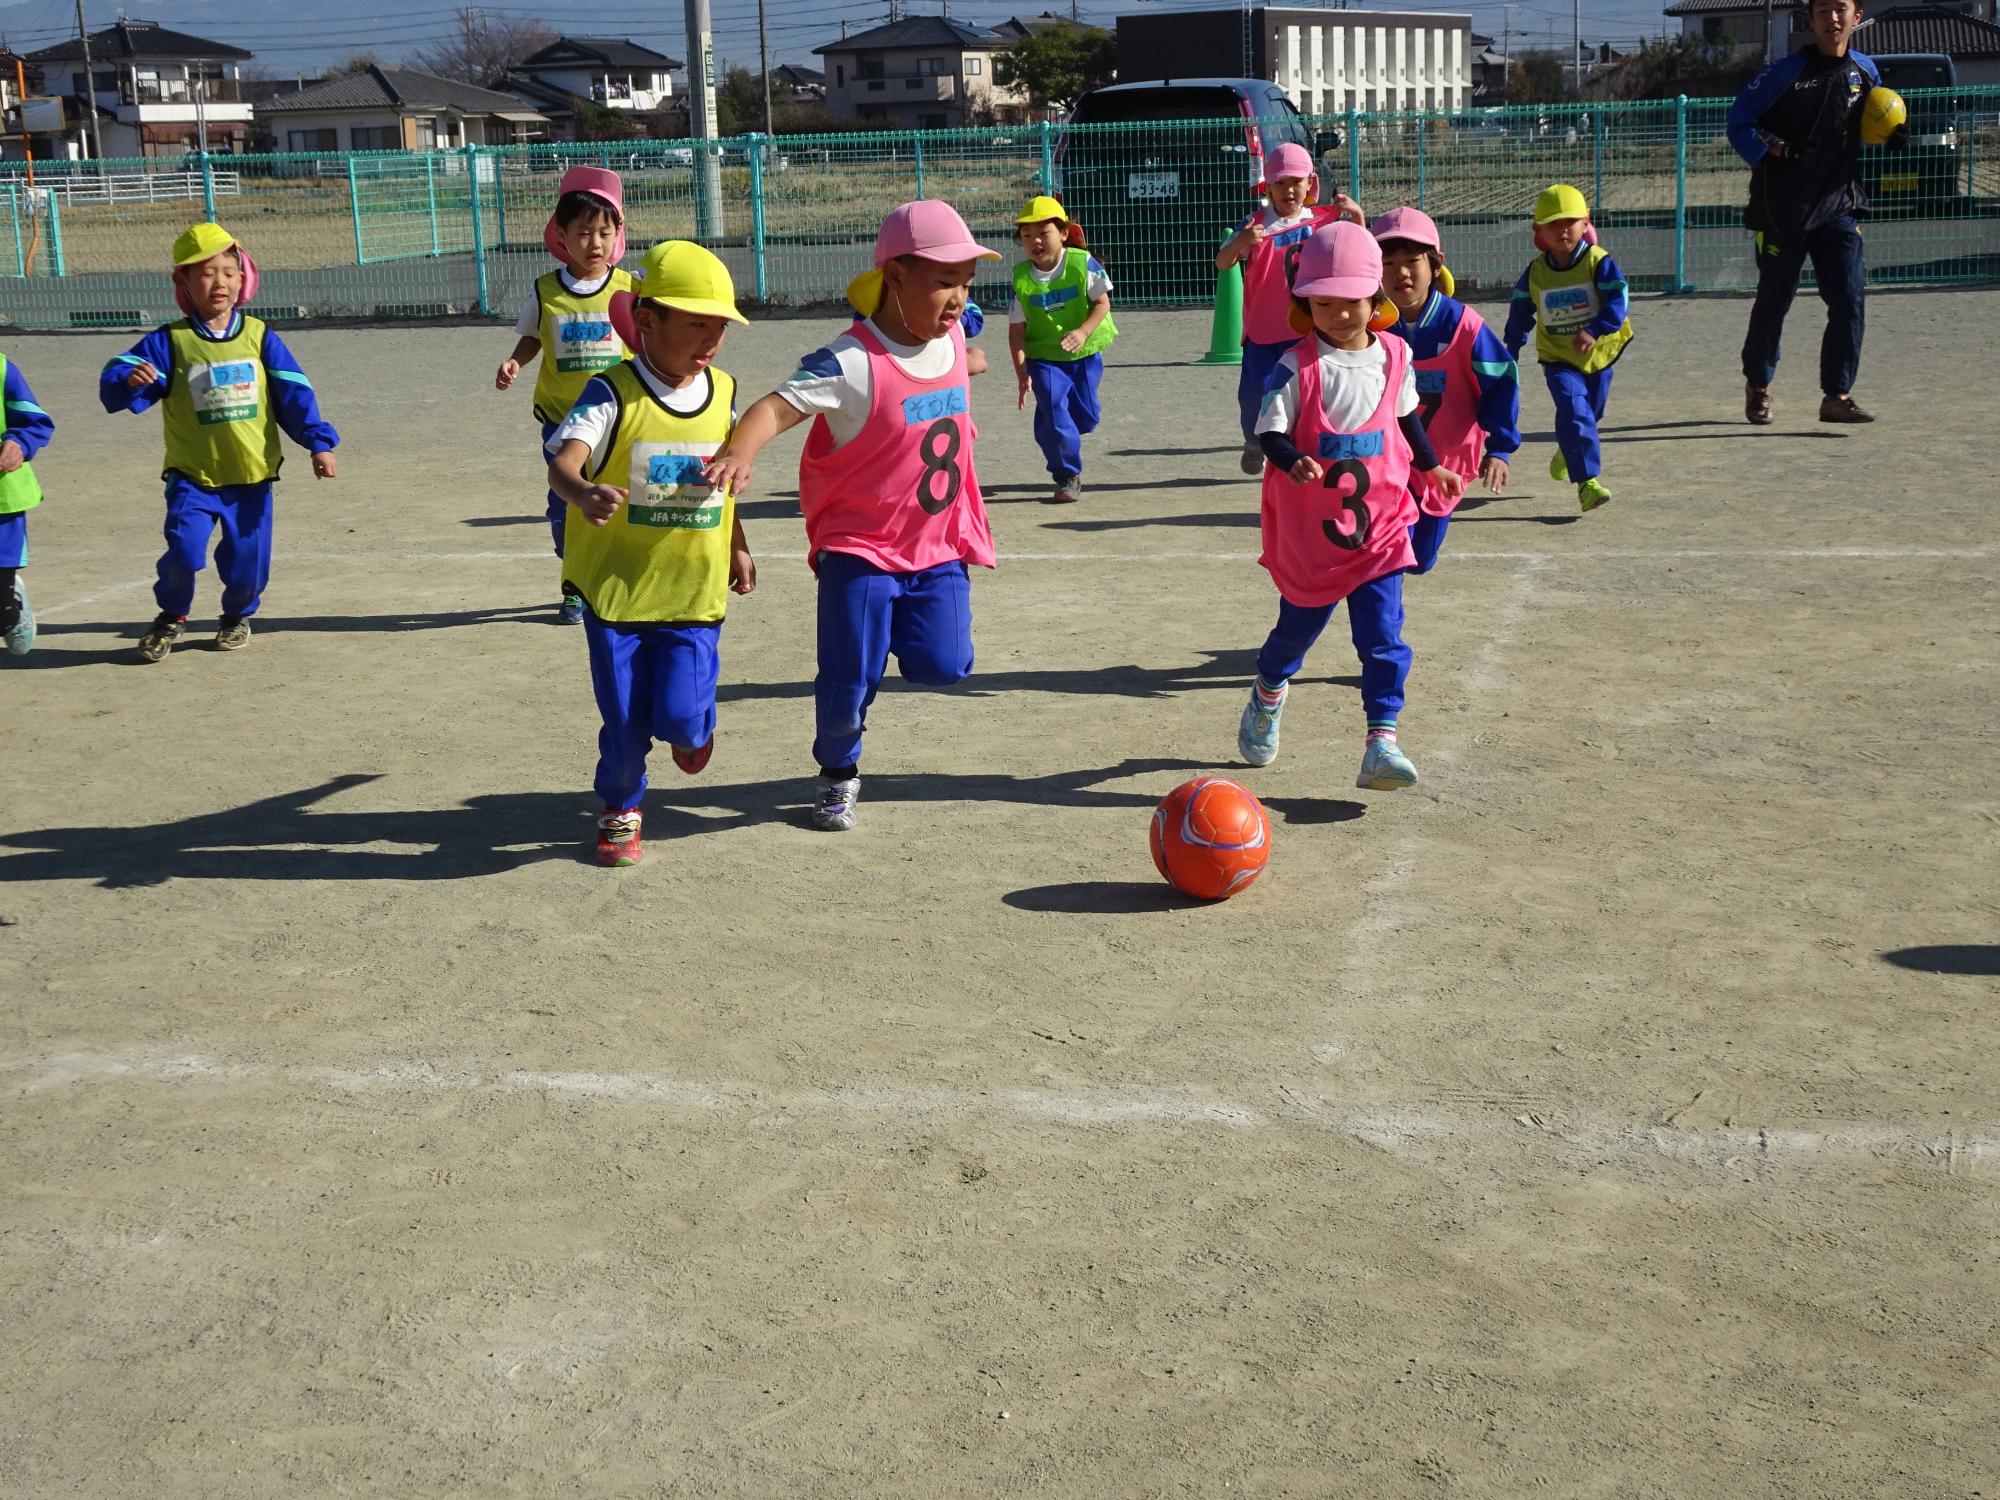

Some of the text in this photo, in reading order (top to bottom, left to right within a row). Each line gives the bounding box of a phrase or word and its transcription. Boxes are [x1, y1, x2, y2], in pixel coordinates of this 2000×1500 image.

[916, 416, 962, 516] 8
[1322, 458, 1372, 551] 3
[650, 512, 712, 523] JFA キッズ キット
